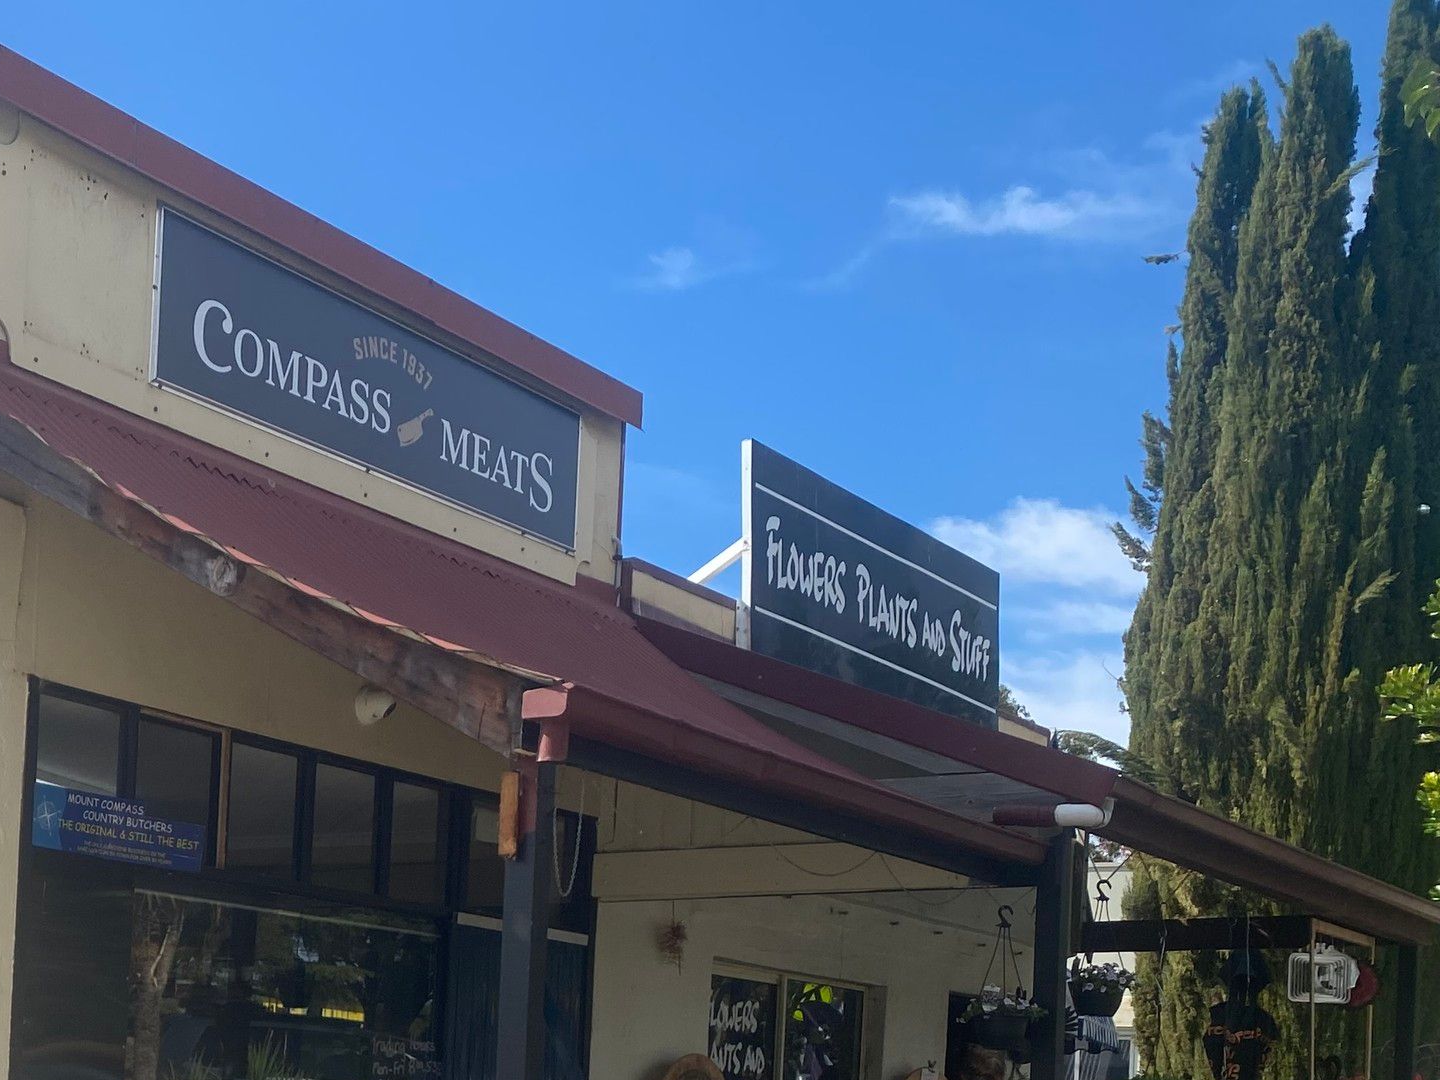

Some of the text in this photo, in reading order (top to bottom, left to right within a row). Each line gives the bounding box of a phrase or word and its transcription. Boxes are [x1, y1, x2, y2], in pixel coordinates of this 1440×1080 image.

[352, 336, 433, 390] SINCE 1937
[193, 299, 553, 513] COMPASS MEATS
[765, 515, 991, 682] FLOWERS PLANTS AND STUFF
[67, 793, 145, 815] MOUNT COMPASS
[58, 818, 74, 830] THE
[74, 822, 117, 839] ORIGINAL
[119, 830, 126, 840] &
[127, 831, 154, 845] STILL
[158, 835, 176, 847] THE
[176, 838, 200, 851] BEST
[83, 810, 173, 834] COUNTRY BUTCHERS
[710, 1000, 760, 1033] LOWERS
[710, 1040, 742, 1075] ANTS
